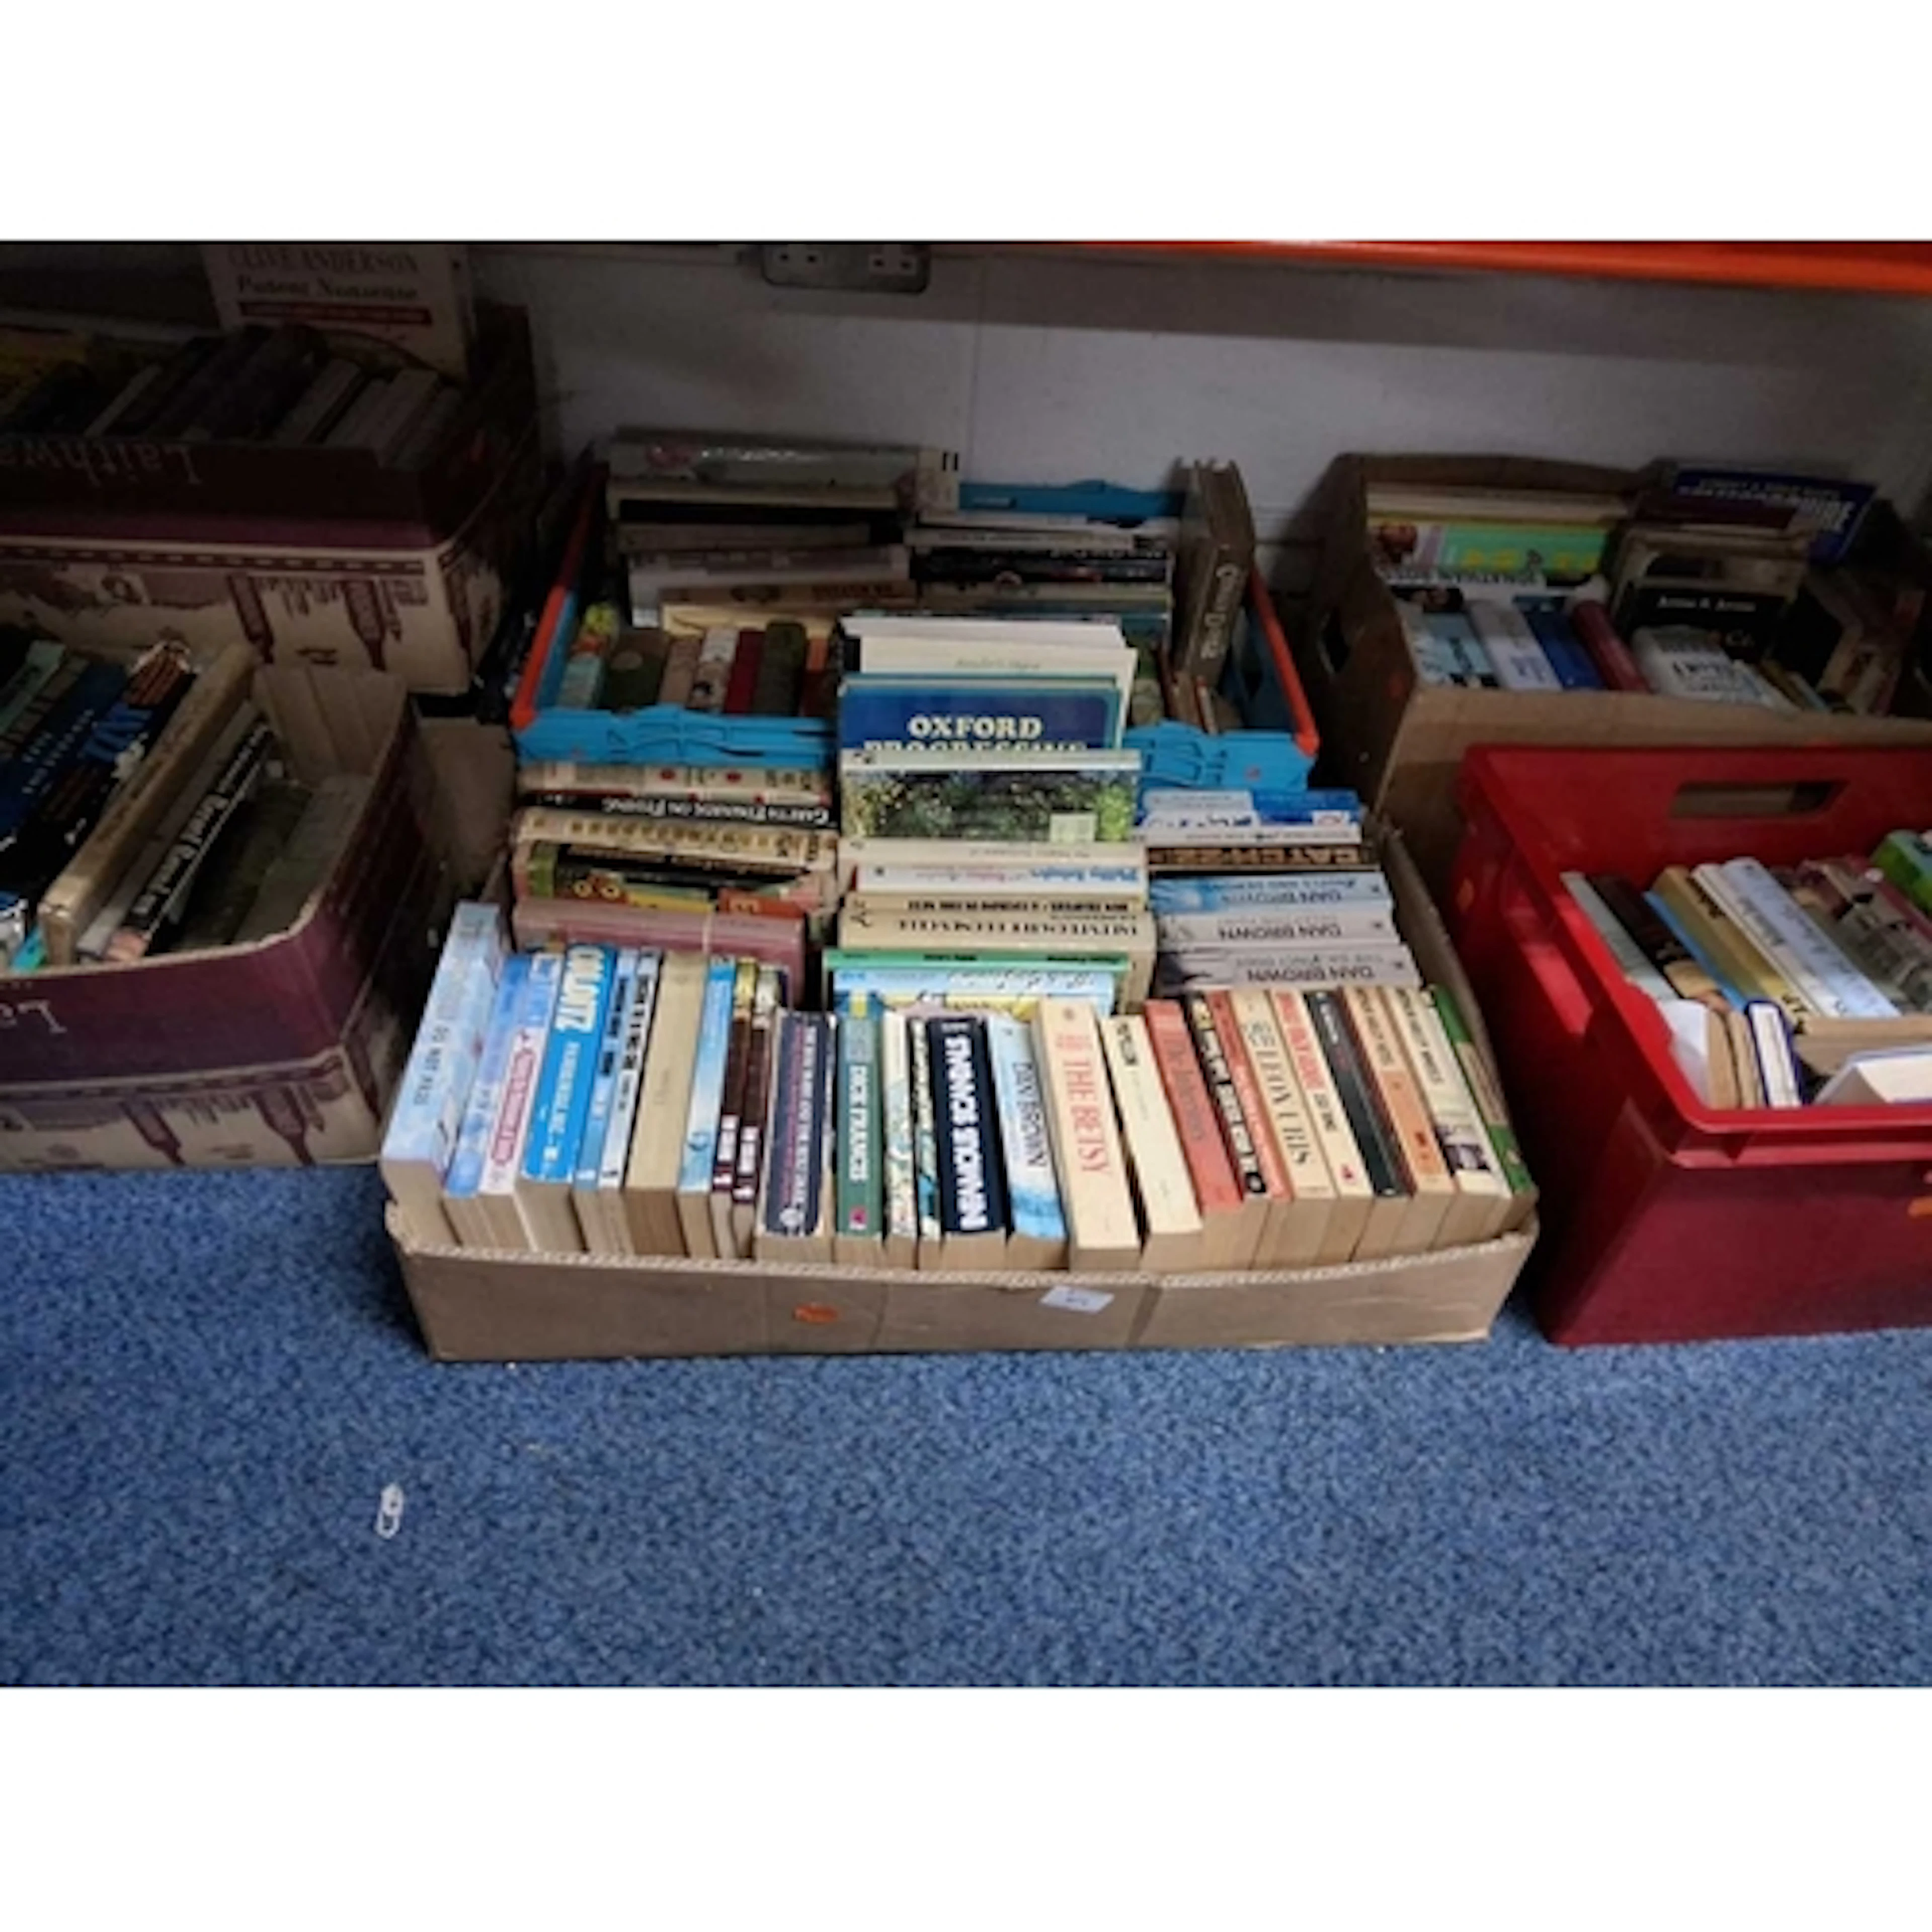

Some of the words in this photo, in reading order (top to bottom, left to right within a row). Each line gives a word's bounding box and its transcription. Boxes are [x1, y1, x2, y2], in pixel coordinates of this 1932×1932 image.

[300, 250, 418, 274] ANDERSON
[907, 715, 1043, 740] OXFORD
[1217, 924, 1294, 940] BROWN
[1298, 922, 1341, 937] DAN
[555, 946, 605, 1033] COLDITZ
[1246, 967, 1325, 982] BROWN
[1329, 965, 1375, 981] DAN
[848, 1065, 869, 1105] DICK
[943, 1035, 980, 1126] SCANDALS
[1013, 1061, 1038, 1100] DAN
[1063, 1060, 1098, 1102] THE
[1255, 1050, 1291, 1105] LEON
[1278, 1112, 1310, 1164] URIS
[847, 1107, 868, 1181] FRANCIS
[1017, 1101, 1048, 1169] BROWN
[1072, 1105, 1112, 1175] BETSY
[951, 1126, 989, 1232] INFAMOUS
